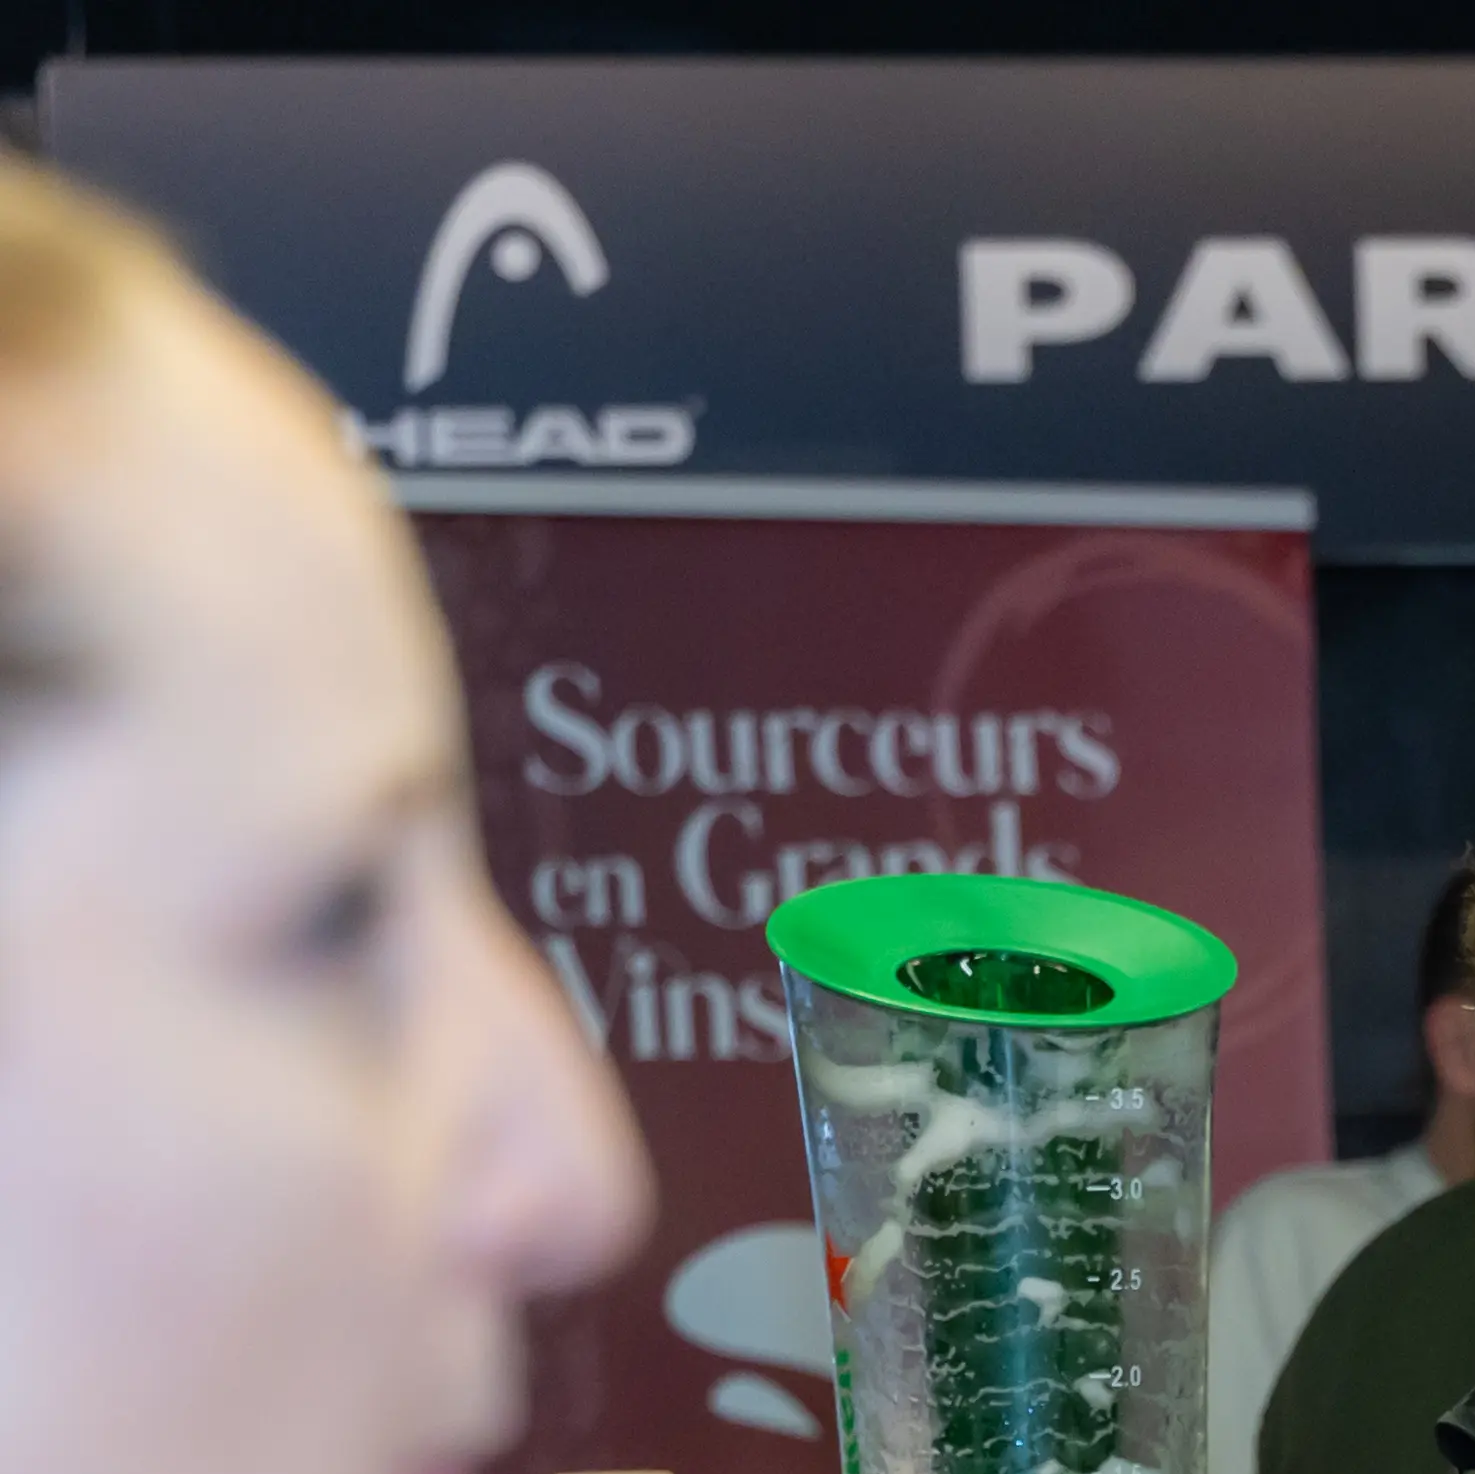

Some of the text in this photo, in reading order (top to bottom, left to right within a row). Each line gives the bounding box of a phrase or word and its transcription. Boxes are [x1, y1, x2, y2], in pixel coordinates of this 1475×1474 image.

[343, 402, 698, 468] HEAD
[522, 661, 1121, 797] Sourceurs
[531, 853, 647, 929] en
[543, 930, 791, 1062] Vins
[1110, 1087, 1144, 1110] 3.5
[1110, 1177, 1143, 1200] 3.0
[1110, 1268, 1142, 1291] 2.5
[1111, 1365, 1142, 1388] 2.0
